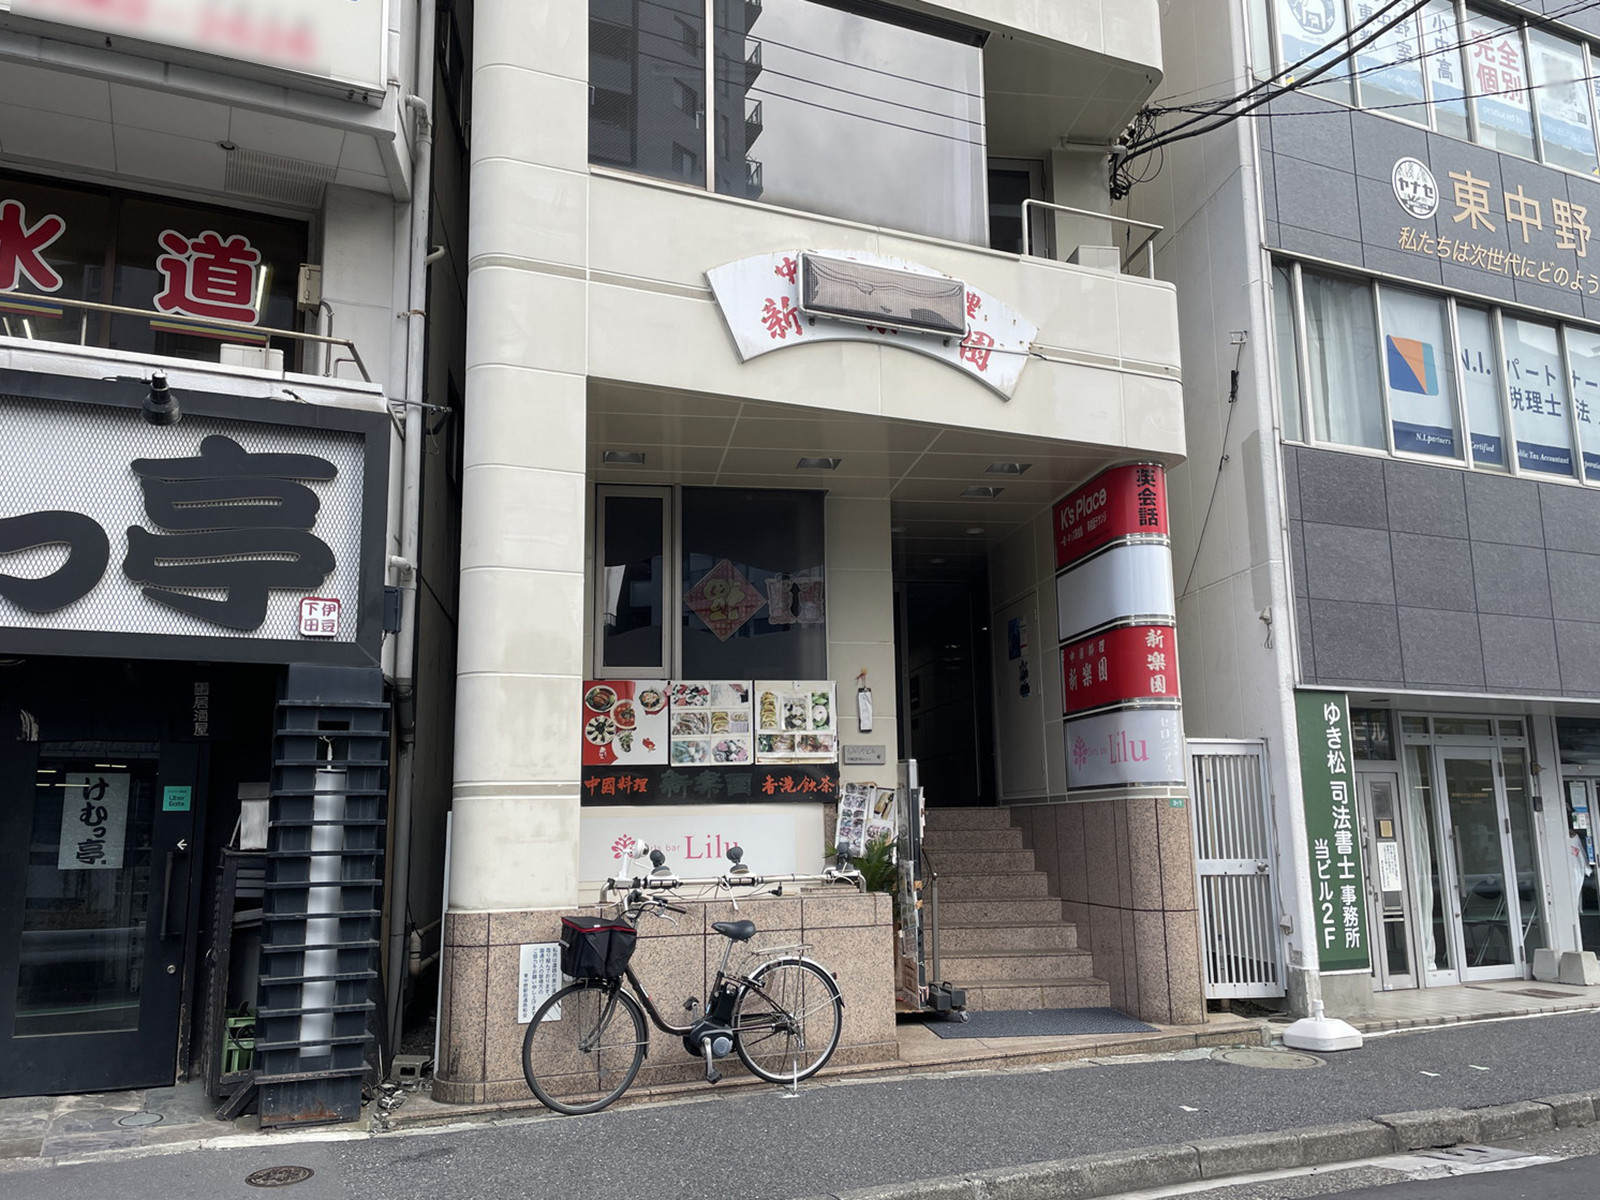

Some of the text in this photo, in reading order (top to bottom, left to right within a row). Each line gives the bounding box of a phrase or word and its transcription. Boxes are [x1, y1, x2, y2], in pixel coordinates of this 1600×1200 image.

[1432, 13, 1453, 83] 小中高
[1471, 28, 1521, 74] 完全
[1476, 62, 1524, 105] 個別
[1448, 170, 1592, 258] 東中野
[1398, 226, 1600, 294] 私たちは次世代にどのよう
[1075, 488, 1107, 521] Place
[1136, 468, 1159, 527] 英会話
[303, 602, 319, 634] 下田
[321, 603, 337, 634] 伊豆
[1108, 730, 1150, 764] Lilu
[666, 843, 680, 852] bar
